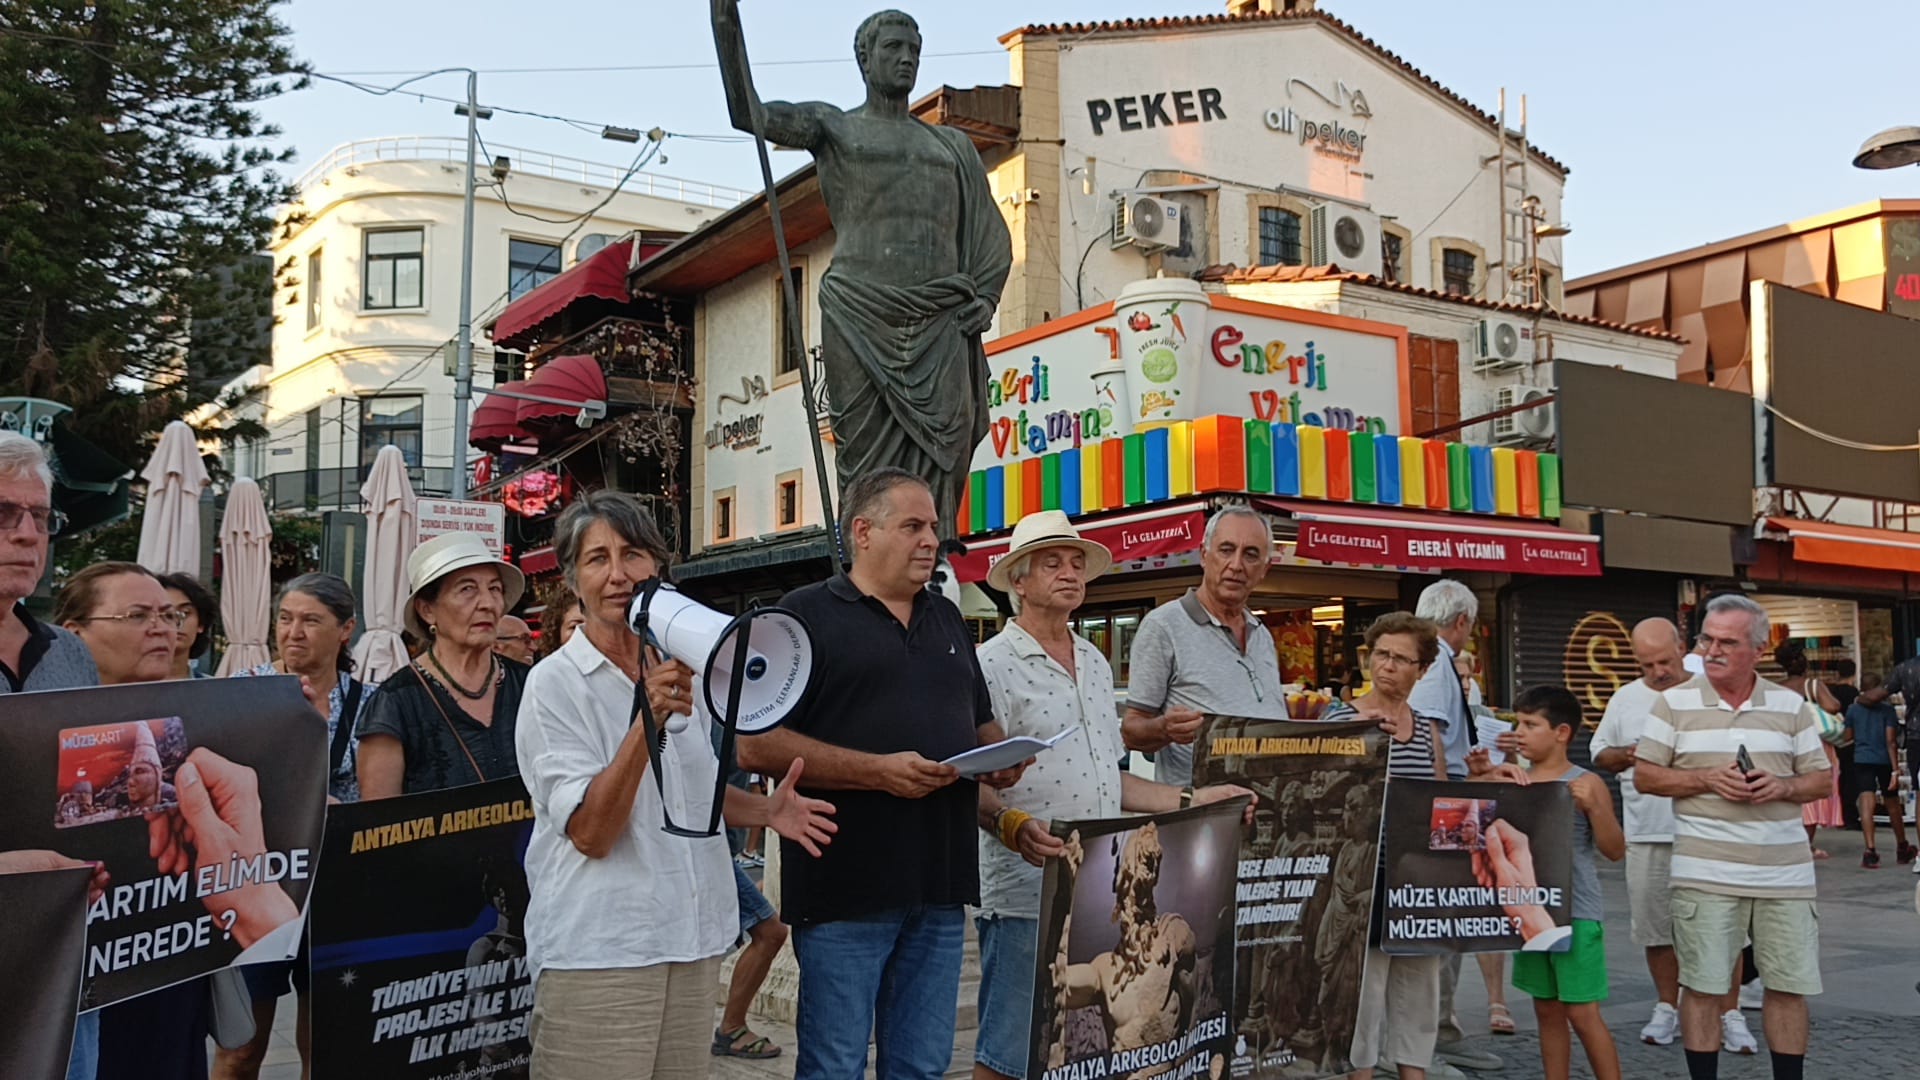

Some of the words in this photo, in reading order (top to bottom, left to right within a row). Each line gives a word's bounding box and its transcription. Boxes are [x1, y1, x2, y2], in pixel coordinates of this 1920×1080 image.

[1086, 87, 1227, 136] PEKER
[1299, 119, 1367, 152] peker
[987, 355, 1049, 409] nerji
[1408, 538, 1452, 557] ENERJİ
[1455, 539, 1506, 560] VİTAMİN
[1211, 737, 1257, 756] ANTALYA
[1259, 736, 1321, 755] ARKEOLOJİ
[1321, 736, 1366, 755] MÜZESİ
[351, 816, 436, 854] ANTALYA
[1262, 856, 1294, 876] BİNA
[1293, 854, 1330, 874] DEĞİL
[87, 871, 189, 925] ARTIM
[196, 849, 310, 898] ELİMDE
[1283, 879, 1317, 898] YILIN
[1388, 884, 1435, 908] MÜZE
[1437, 886, 1494, 907] KARTIM
[1497, 883, 1562, 906] ELİMDE
[88, 915, 212, 978] NEREDE
[221, 909, 237, 941] ?
[1388, 915, 1451, 939] MÜZEM
[1455, 916, 1511, 937] NEREDE
[1513, 917, 1522, 935] ?
[371, 959, 510, 1013] TÜRKİYE'NİN
[373, 994, 471, 1044] PROJESİ
[471, 989, 506, 1019] İLE
[408, 1033, 447, 1064] İLK
[1109, 1029, 1188, 1075] ARKEOLOJİ
[1184, 1010, 1227, 1051] MÜZESİ
